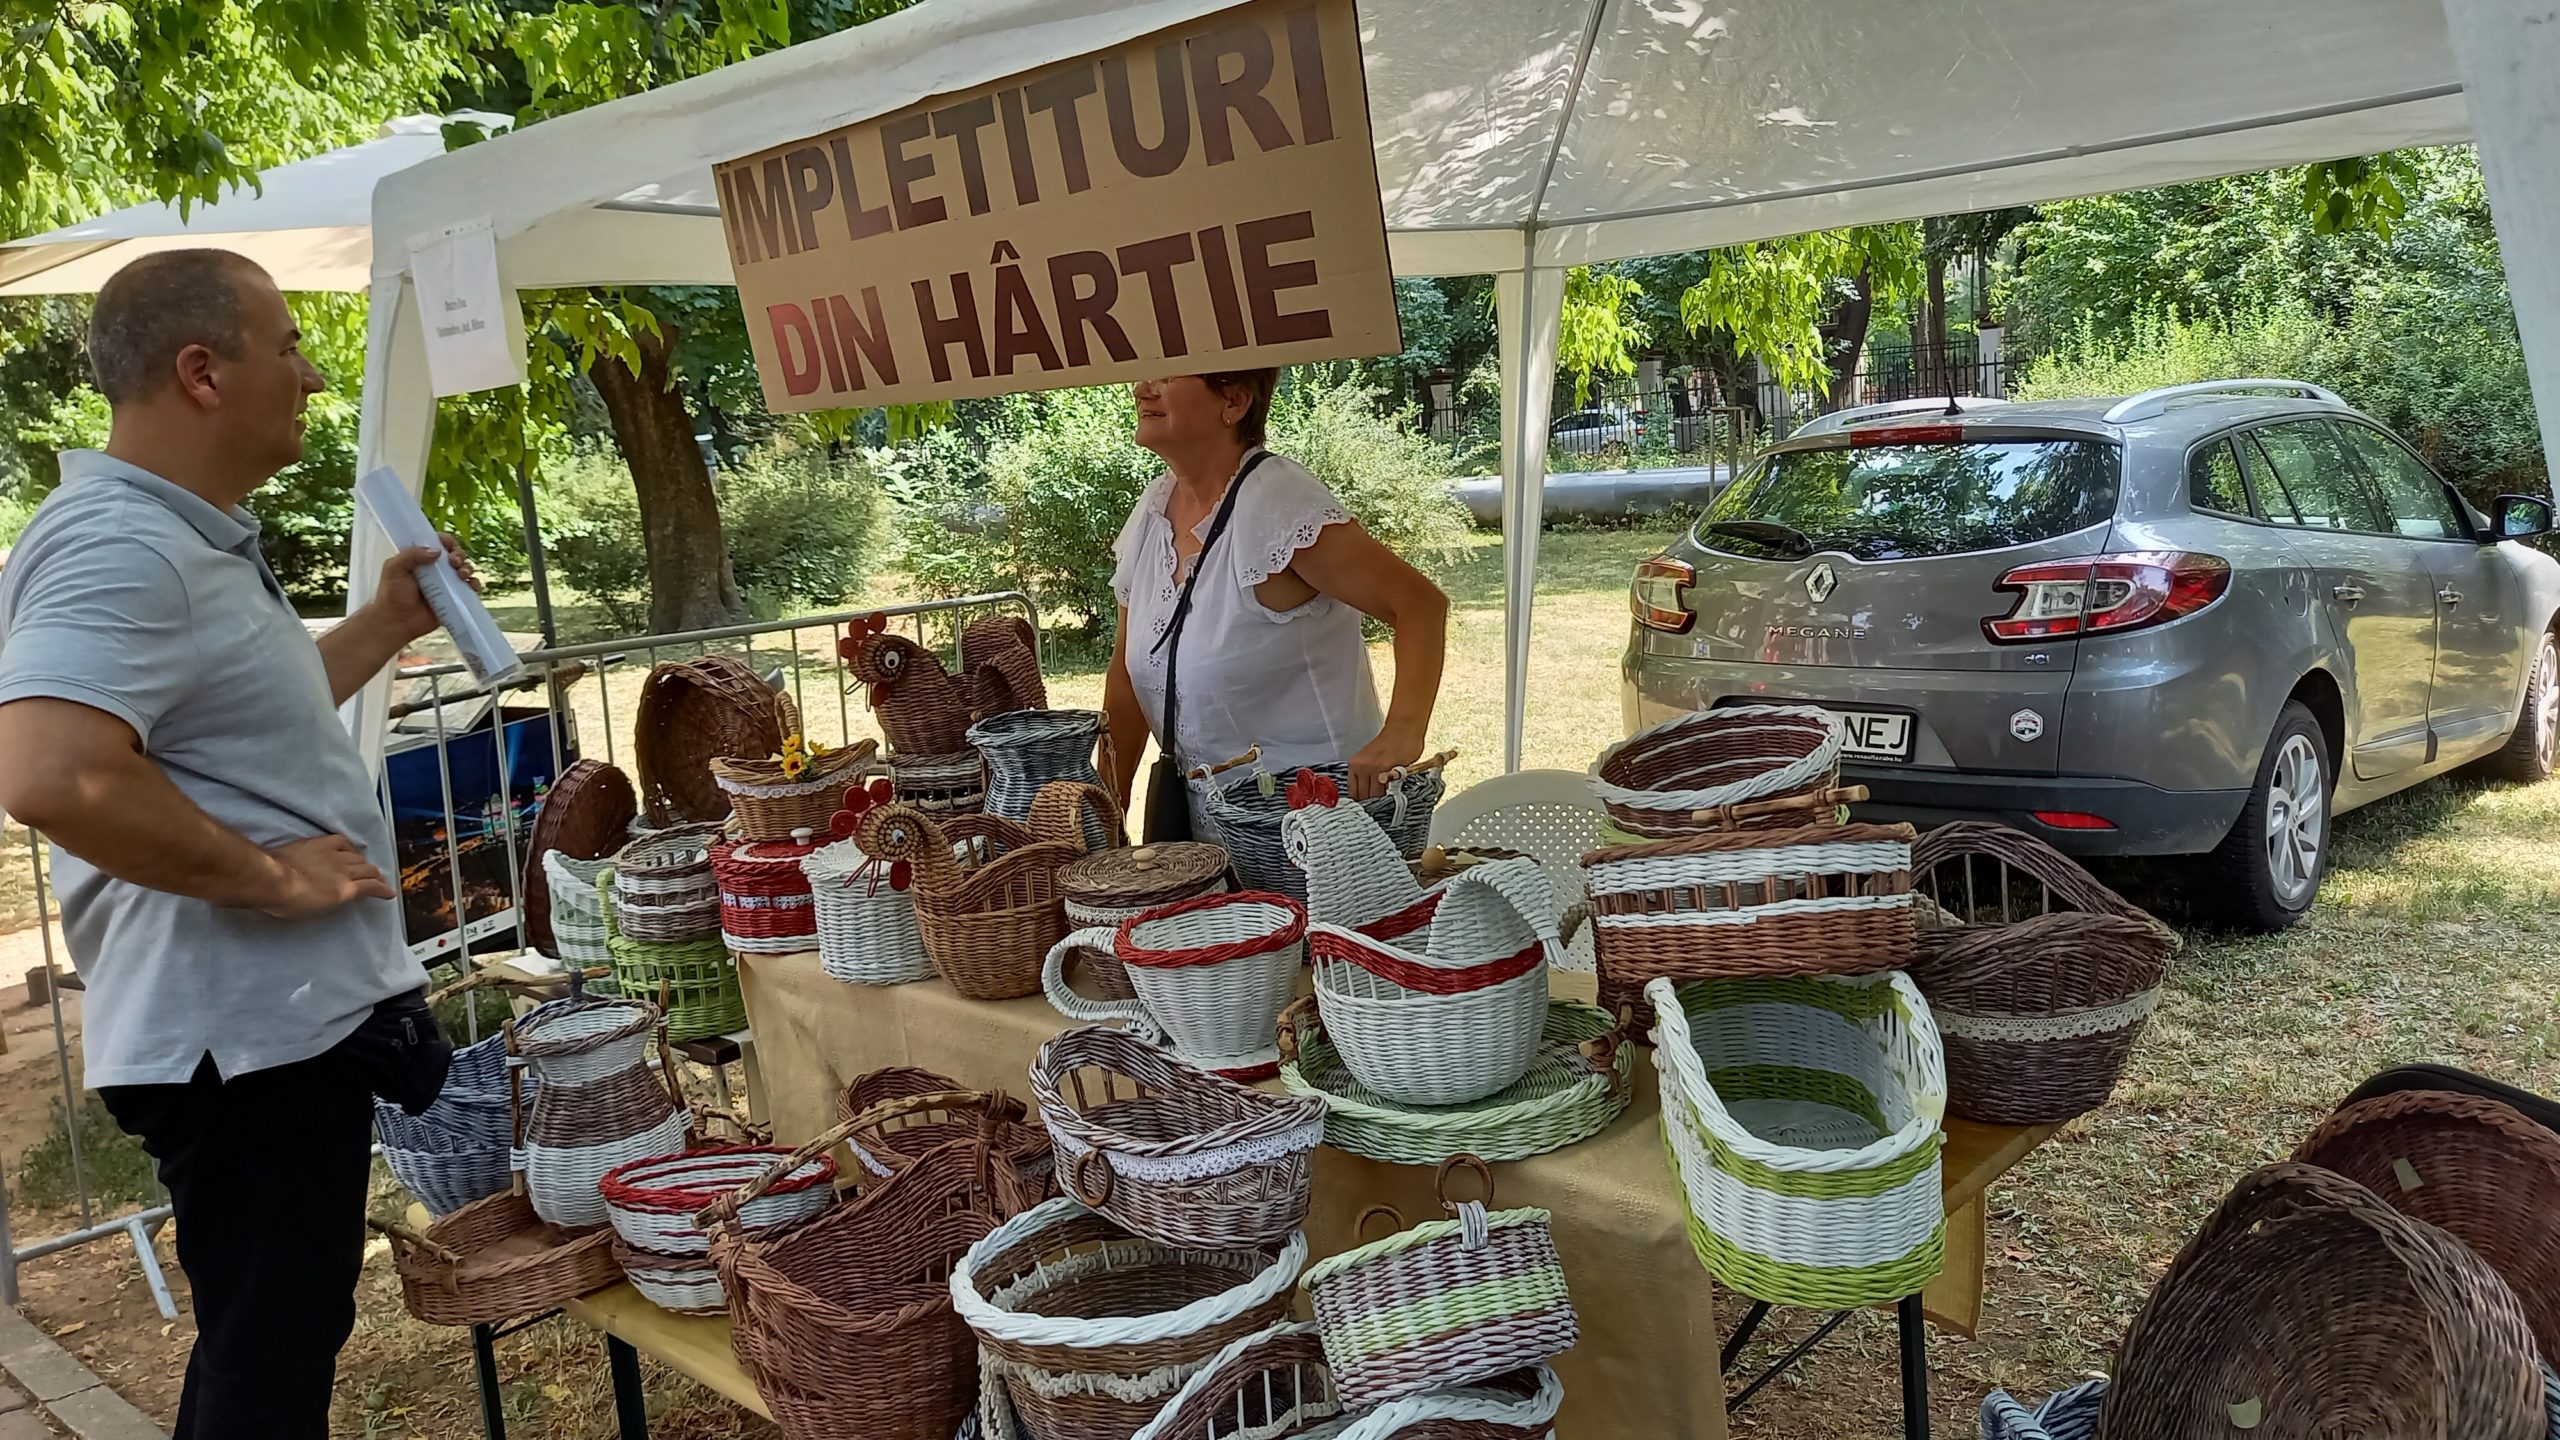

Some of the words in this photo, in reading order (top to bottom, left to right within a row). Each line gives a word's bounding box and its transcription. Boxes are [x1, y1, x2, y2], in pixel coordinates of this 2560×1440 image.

[767, 286, 900, 396] DIN
[911, 211, 1333, 383] HÂRTIE
[1767, 625, 1867, 640] MEGANE
[1841, 716, 1907, 749] NEJ
